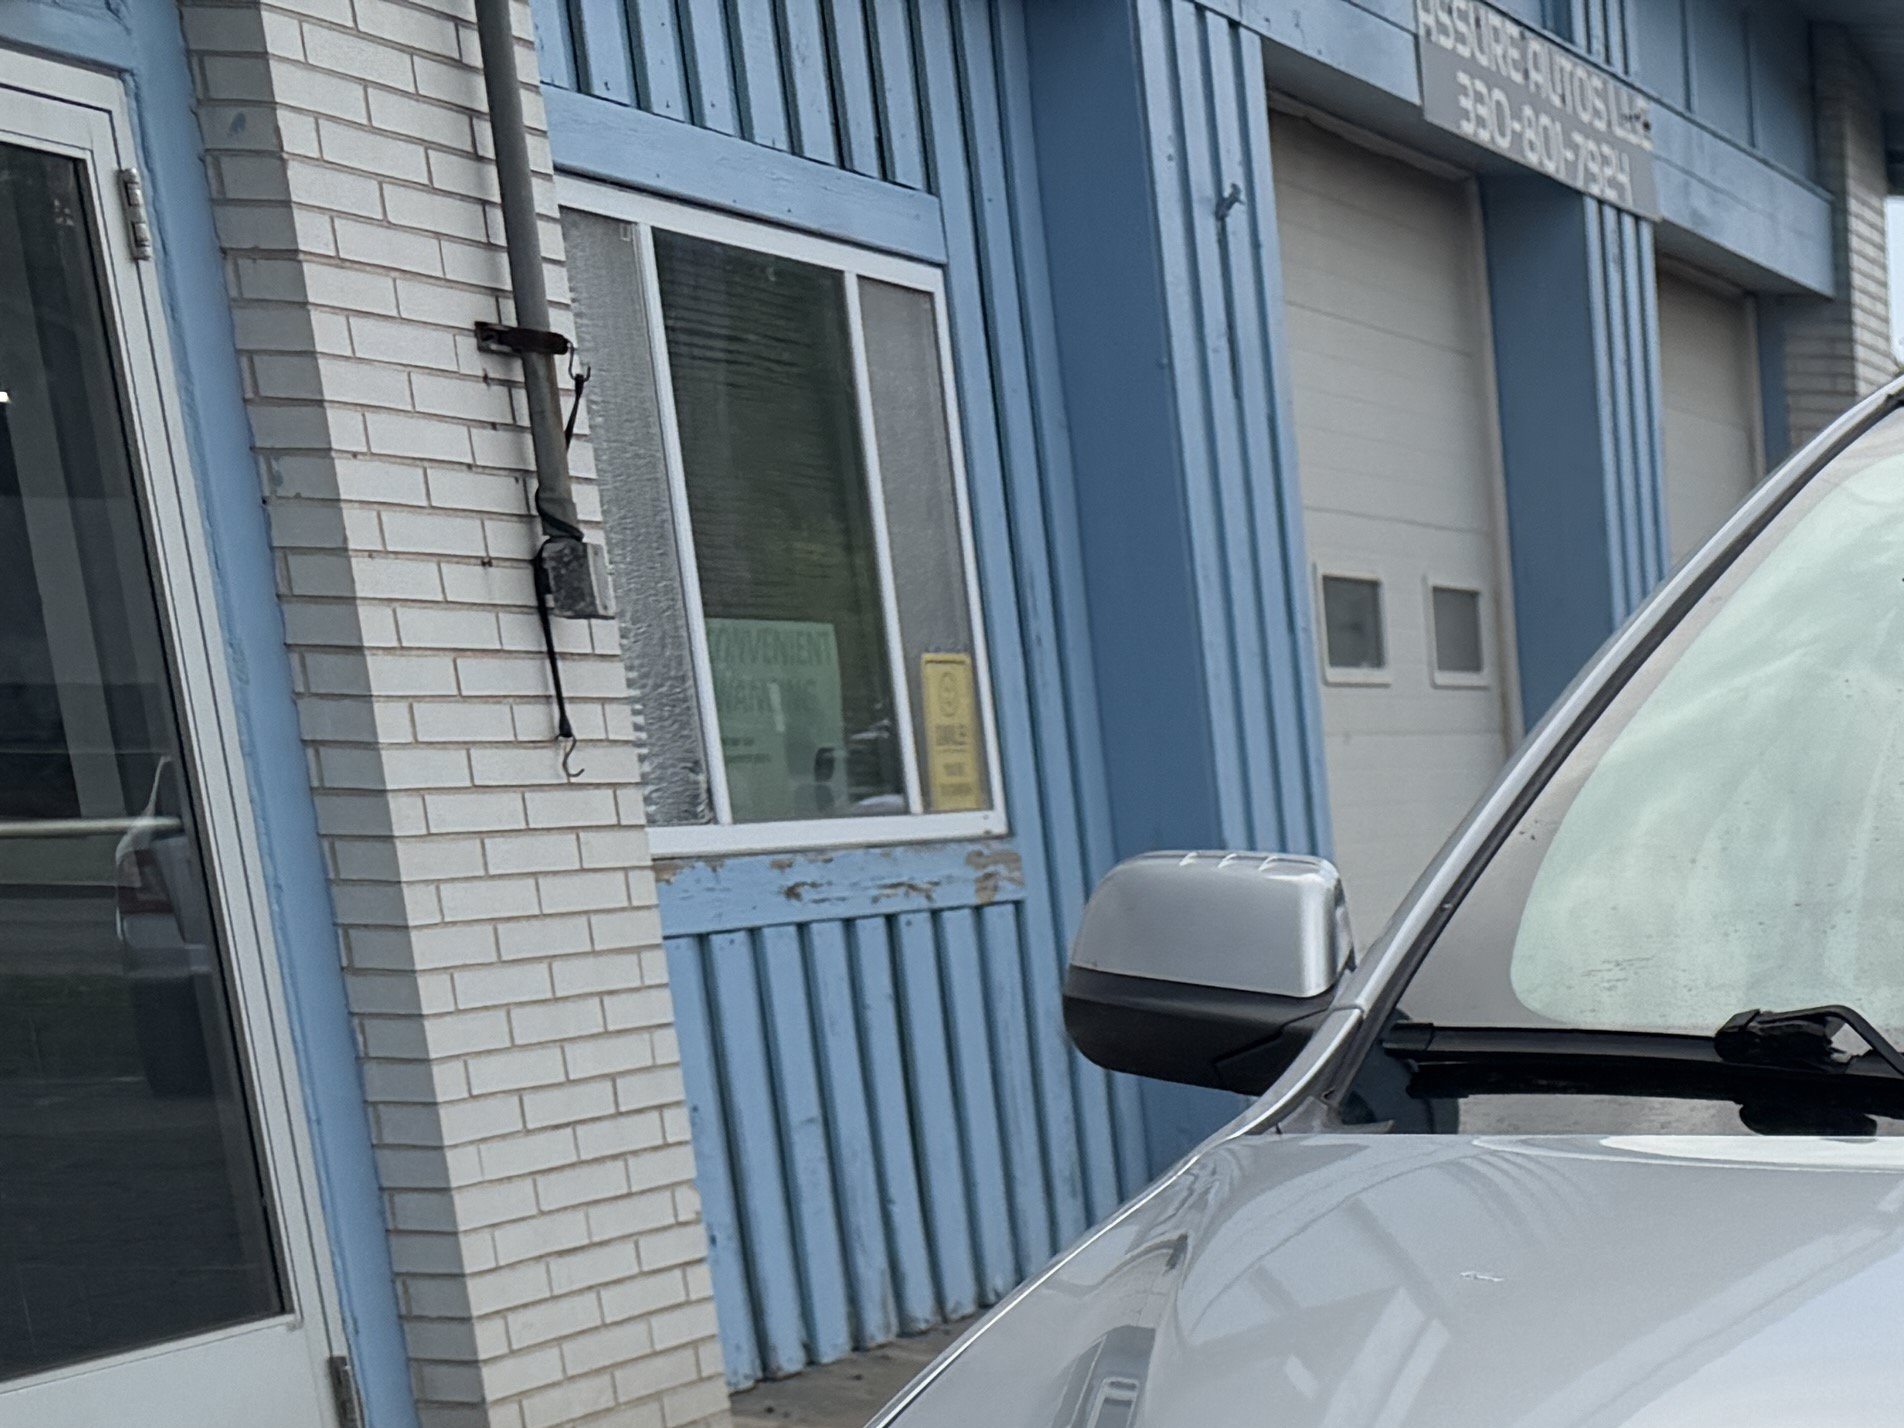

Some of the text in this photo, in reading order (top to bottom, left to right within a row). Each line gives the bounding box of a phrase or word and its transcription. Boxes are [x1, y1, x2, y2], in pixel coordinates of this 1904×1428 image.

[1417, 0, 1526, 86] ASSURE
[1527, 38, 1608, 132] AUTOS
[1455, 70, 1634, 209] 330-801-7924
